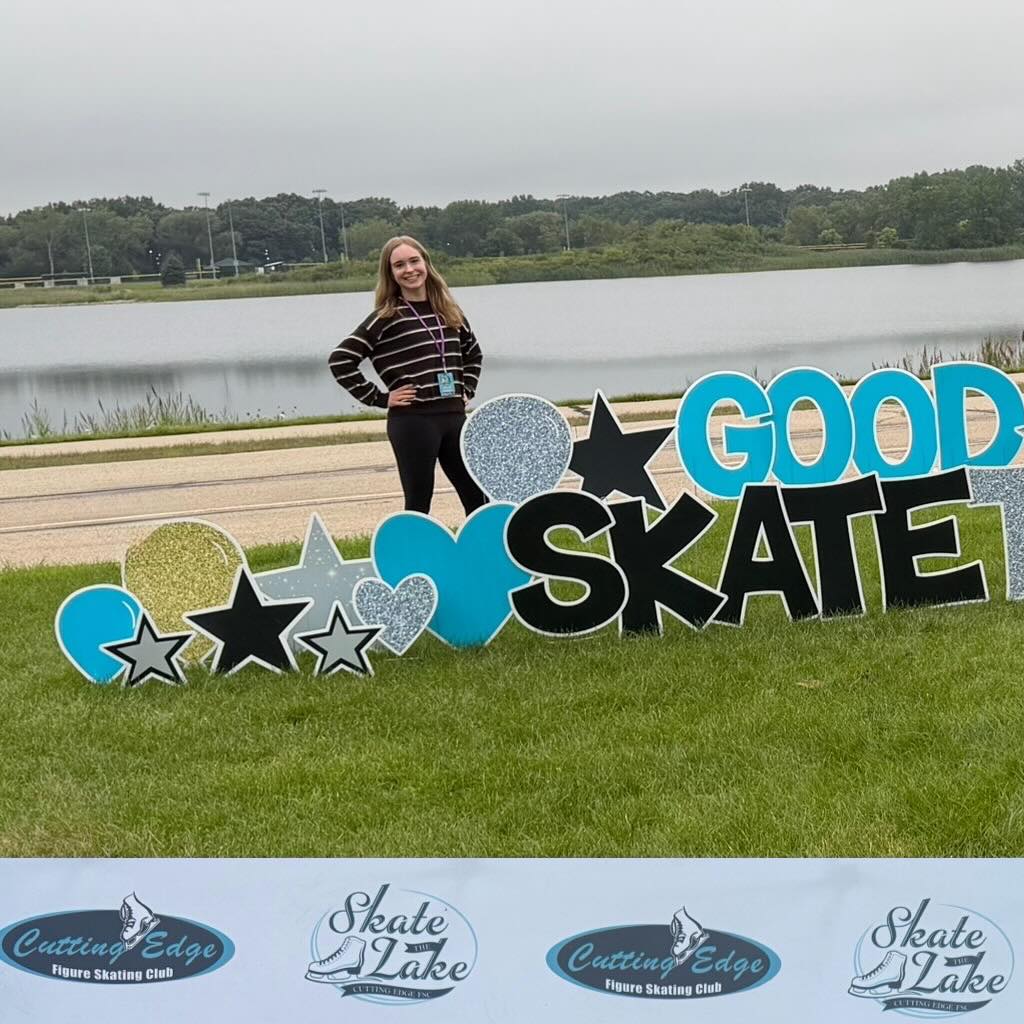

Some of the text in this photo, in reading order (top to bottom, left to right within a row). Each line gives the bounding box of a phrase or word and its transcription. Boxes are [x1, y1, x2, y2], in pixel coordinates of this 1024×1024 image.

[505, 466, 988, 638] SKATE
[329, 883, 449, 935] Skate
[872, 898, 987, 949] Skate
[13, 928, 217, 965] Cutting Edge
[366, 937, 469, 981] Lake
[568, 943, 764, 981] Cutting Edge
[52, 964, 173, 981] Figure Skating Club
[605, 979, 722, 996] Figure Skating Club
[907, 951, 1006, 993] Lake
